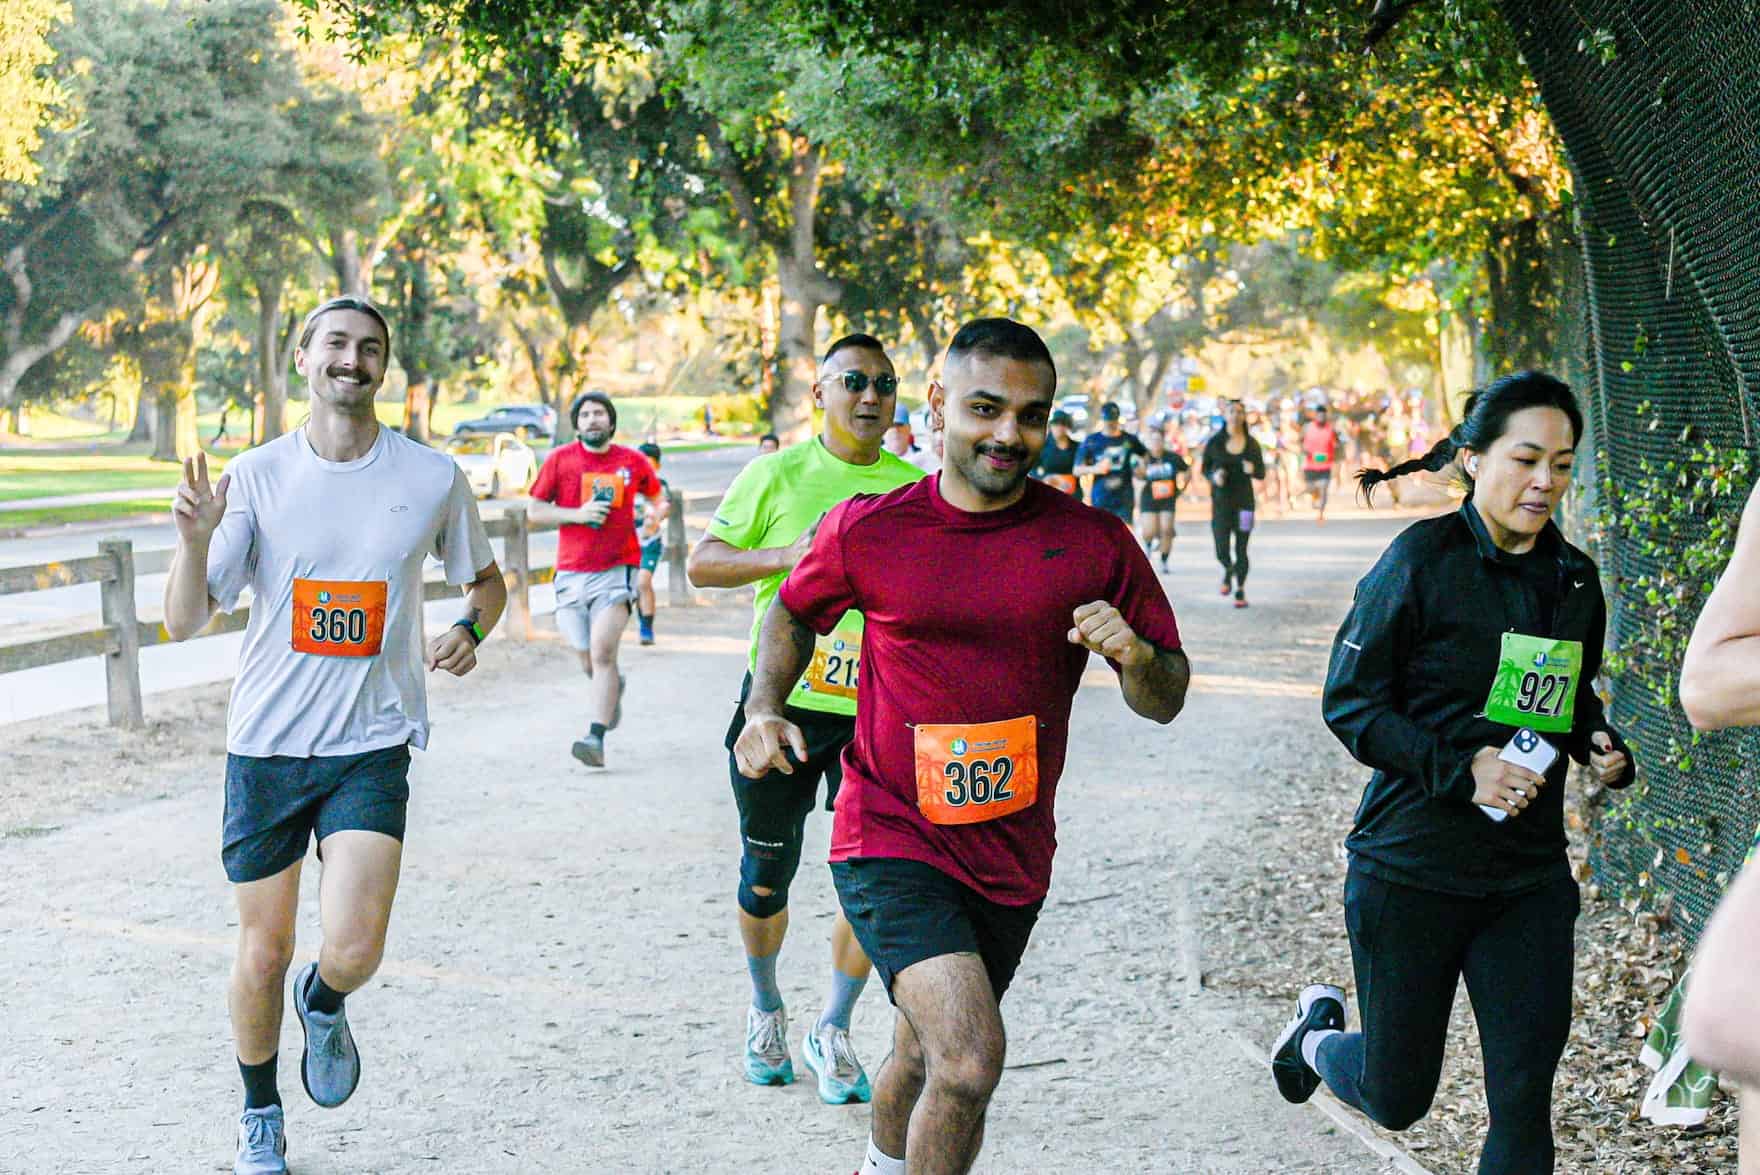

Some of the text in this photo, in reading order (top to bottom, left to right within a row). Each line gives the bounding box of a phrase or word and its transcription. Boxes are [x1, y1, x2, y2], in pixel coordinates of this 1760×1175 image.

[311, 607, 366, 644] 360
[1516, 671, 1571, 717] 927
[944, 756, 1014, 806] 362
